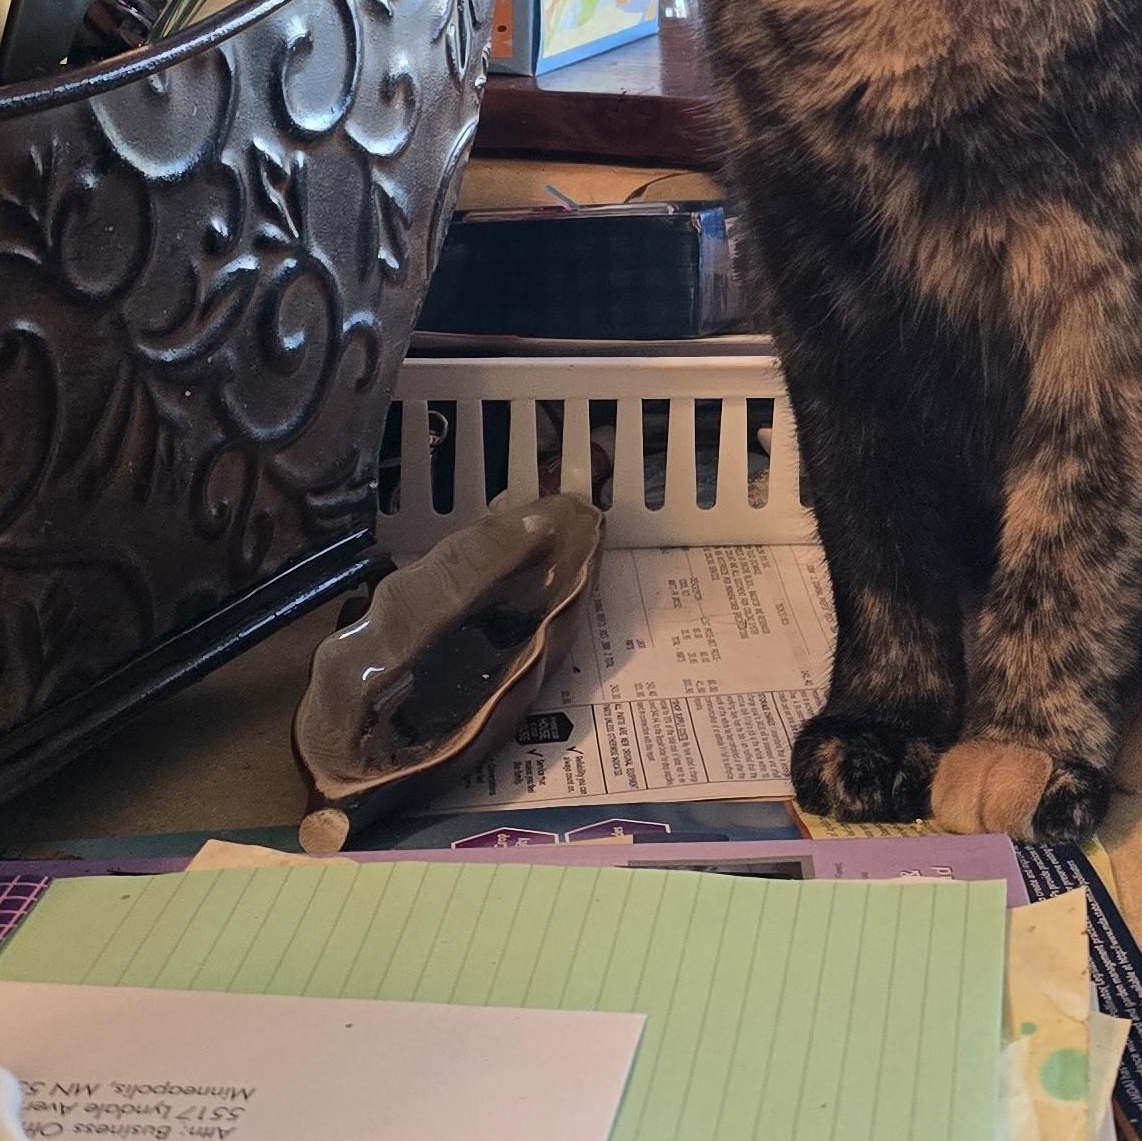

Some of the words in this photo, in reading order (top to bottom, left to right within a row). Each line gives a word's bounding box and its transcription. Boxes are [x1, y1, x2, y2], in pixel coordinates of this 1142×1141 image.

[1114, 982, 1137, 1008] garden
[1123, 1007, 1141, 1022] and
[50, 1081, 101, 1097] MN
[109, 1080, 257, 1101] Minneapolis,
[84, 1100, 172, 1120] Lyndale
[175, 1105, 247, 1121] 5517
[73, 1122, 172, 1140] Business
